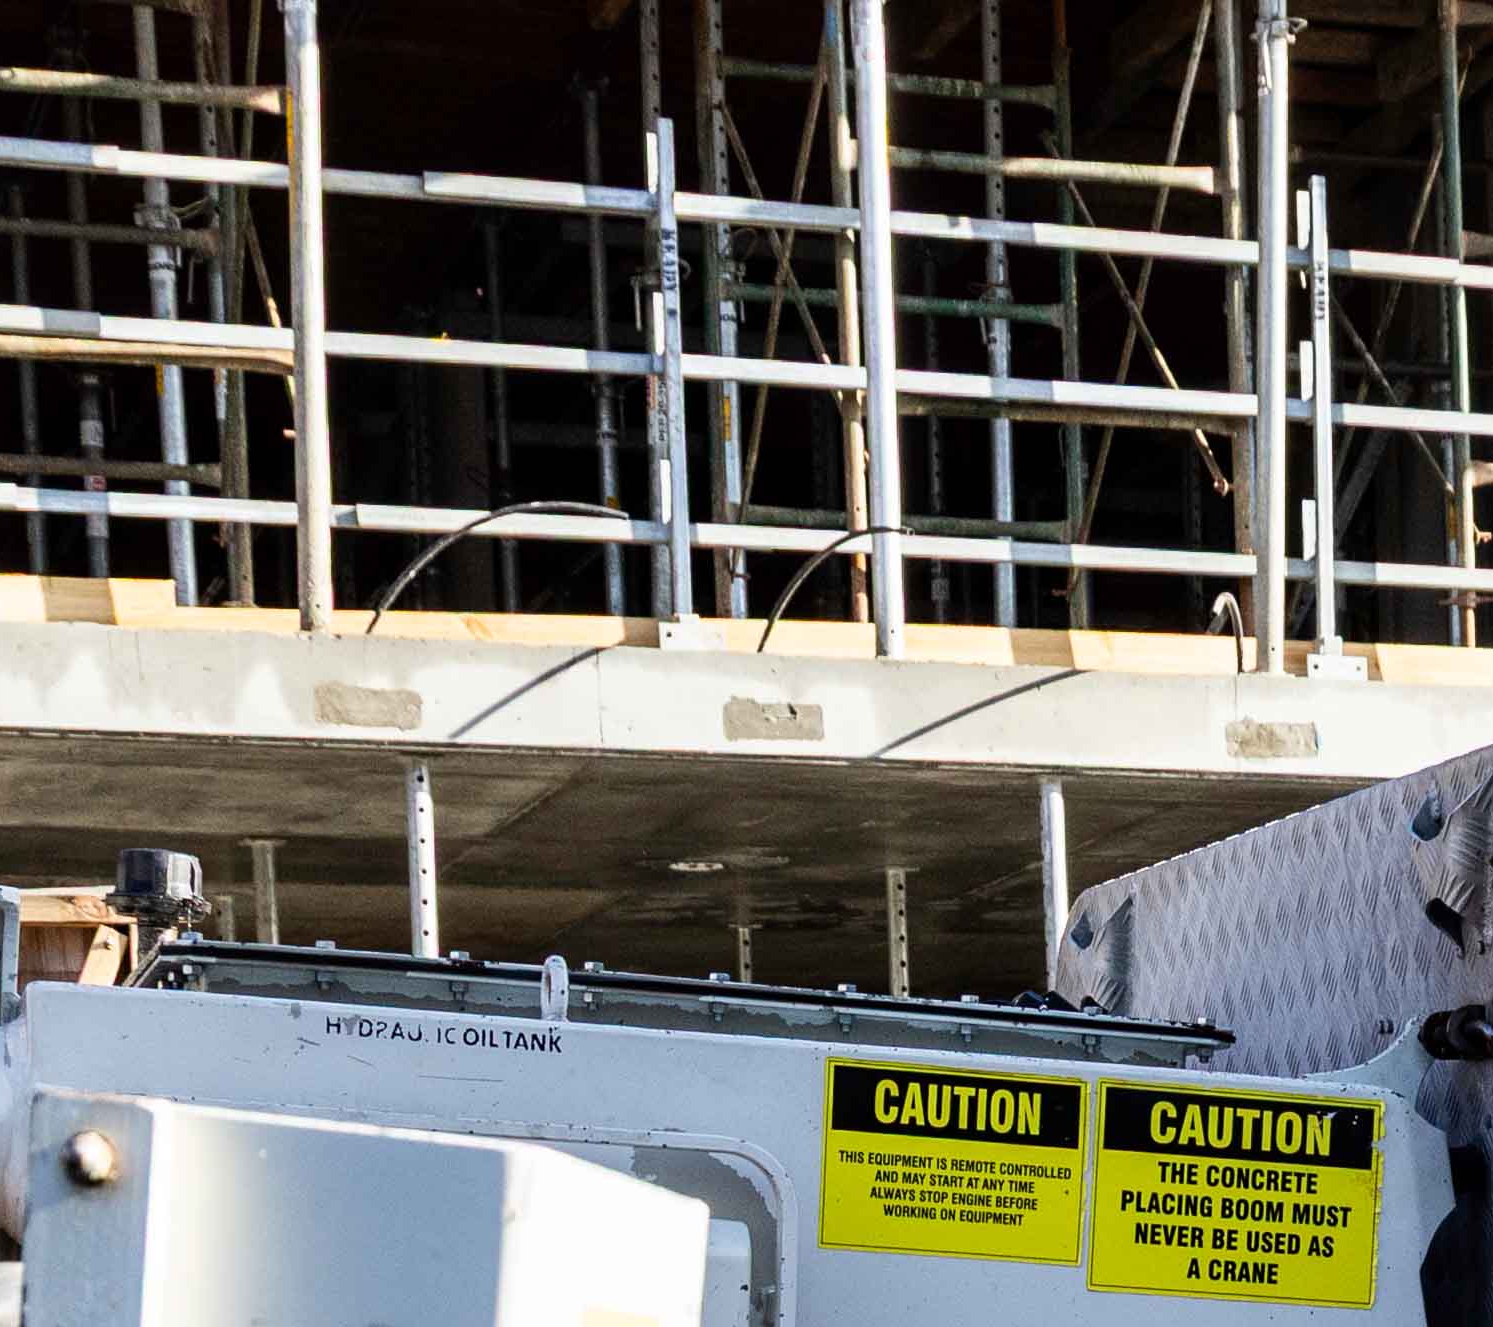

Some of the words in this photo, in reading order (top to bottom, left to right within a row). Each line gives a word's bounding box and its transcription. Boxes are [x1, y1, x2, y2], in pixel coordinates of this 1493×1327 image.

[463, 1028, 499, 1047] OIL
[503, 1030, 562, 1053] TANK
[874, 1078, 1042, 1136] CAUTION
[1149, 1100, 1333, 1157] CAUTION
[838, 1150, 864, 1164] THIS
[868, 1152, 933, 1169] EQUIPMENT
[936, 1157, 947, 1170] IS
[950, 1158, 996, 1174] REMOTE
[999, 1163, 1072, 1179] CONTROLLED
[1158, 1161, 1199, 1185] THE
[1205, 1165, 1318, 1195] CONCRETE
[874, 1169, 898, 1183] AND
[902, 1171, 925, 1185] MAY
[928, 1175, 964, 1188] START
[966, 1176, 980, 1189] AT
[982, 1178, 1004, 1191] ANY
[1008, 1180, 1035, 1194] TIME
[870, 1187, 916, 1202] ALWAYS
[919, 1190, 948, 1204] STOP
[951, 1192, 992, 1207] ENGINE
[995, 1195, 1038, 1211] BEFORE
[1120, 1190, 1213, 1218] PLACING
[1220, 1198, 1284, 1223] BOOM
[1292, 1203, 1352, 1228] MUST
[883, 1204, 936, 1221] WORKING
[940, 1207, 956, 1222] ON
[959, 1209, 1023, 1226] EQUIPMENT
[1134, 1222, 1204, 1249] NEVER
[1211, 1228, 1238, 1250] BE
[1246, 1230, 1301, 1256] USED
[1307, 1235, 1335, 1258] AS
[1187, 1258, 1201, 1280] A
[1208, 1259, 1279, 1285] CRANE
